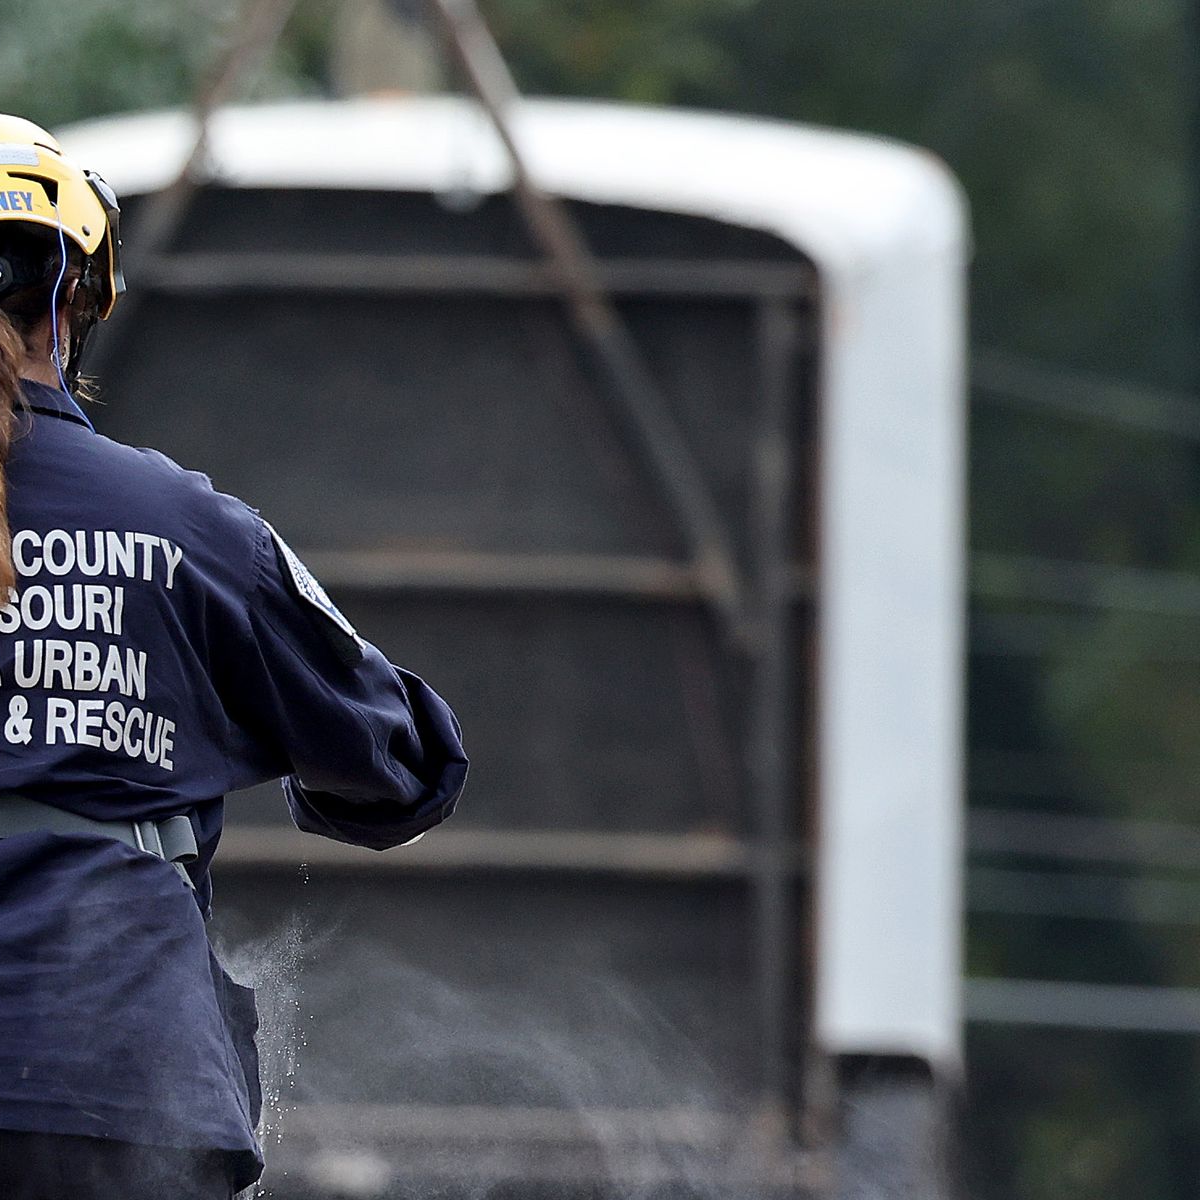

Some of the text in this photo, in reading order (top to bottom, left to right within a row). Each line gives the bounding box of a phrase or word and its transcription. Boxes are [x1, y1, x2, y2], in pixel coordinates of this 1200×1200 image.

[12, 529, 182, 589] COUNTY
[14, 639, 147, 700] URBAN
[4, 695, 33, 746] &
[46, 697, 176, 772] RESCUE
